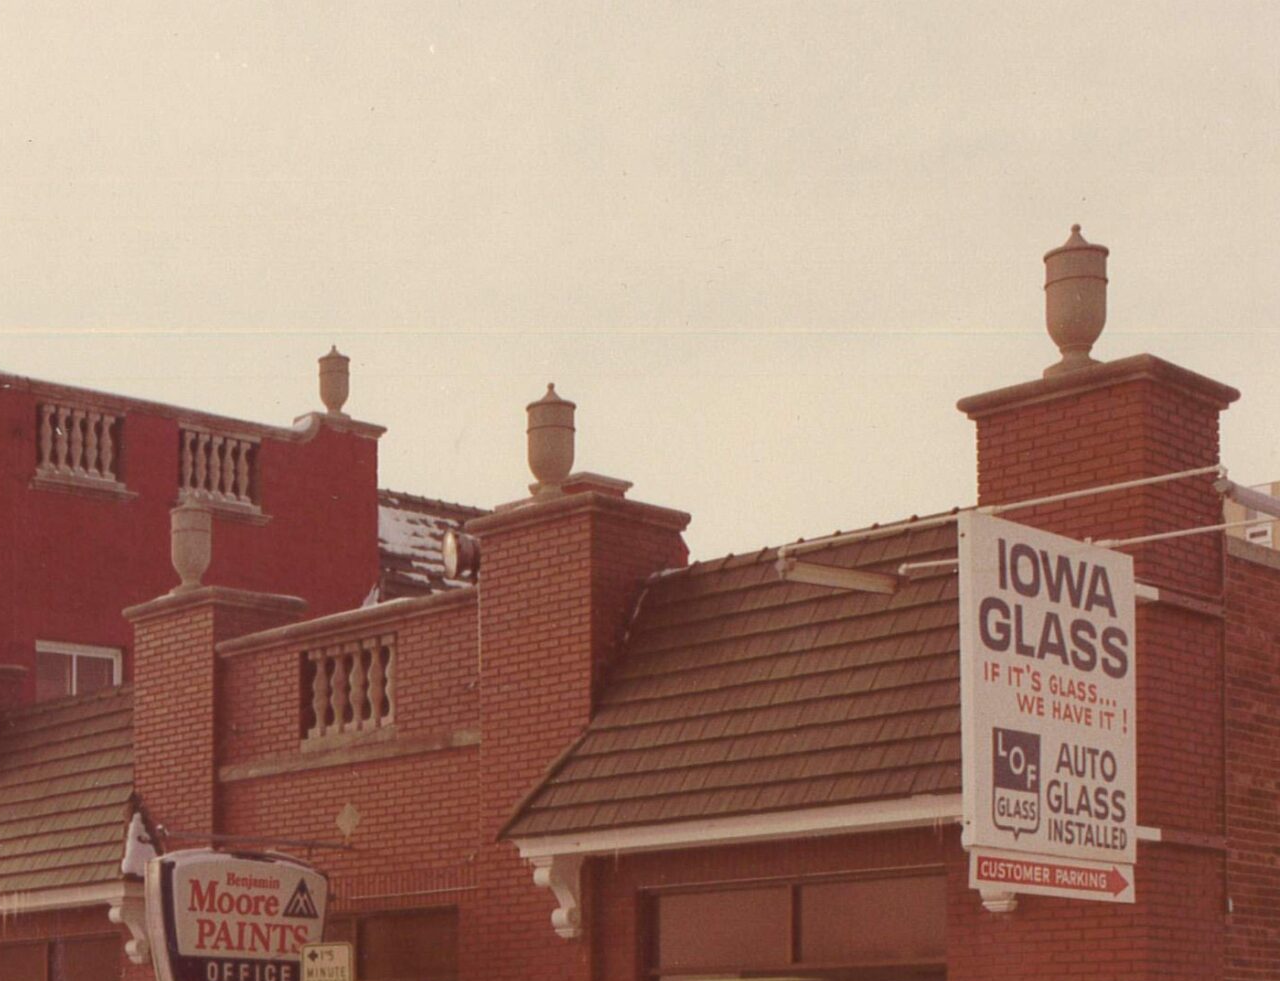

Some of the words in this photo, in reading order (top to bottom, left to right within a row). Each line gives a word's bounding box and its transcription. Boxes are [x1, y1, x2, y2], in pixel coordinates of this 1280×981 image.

[998, 537, 1118, 619] IOWA
[978, 596, 1129, 680] GLASS
[983, 661, 1000, 683] IF
[1007, 664, 1042, 693] IT'S
[1016, 692, 1045, 717] WE
[1052, 700, 1093, 727] HAVE
[1055, 742, 1118, 783] AUTO
[996, 796, 1037, 822] GLASS
[1046, 779, 1127, 823] GLASS
[1047, 817, 1128, 850] INSTALLED
[226, 871, 280, 890] Benjamin
[980, 860, 1051, 883] CUSTOMER
[1054, 868, 1108, 890] PARKING
[187, 878, 280, 917] Moore
[194, 917, 309, 955] PAINTS
